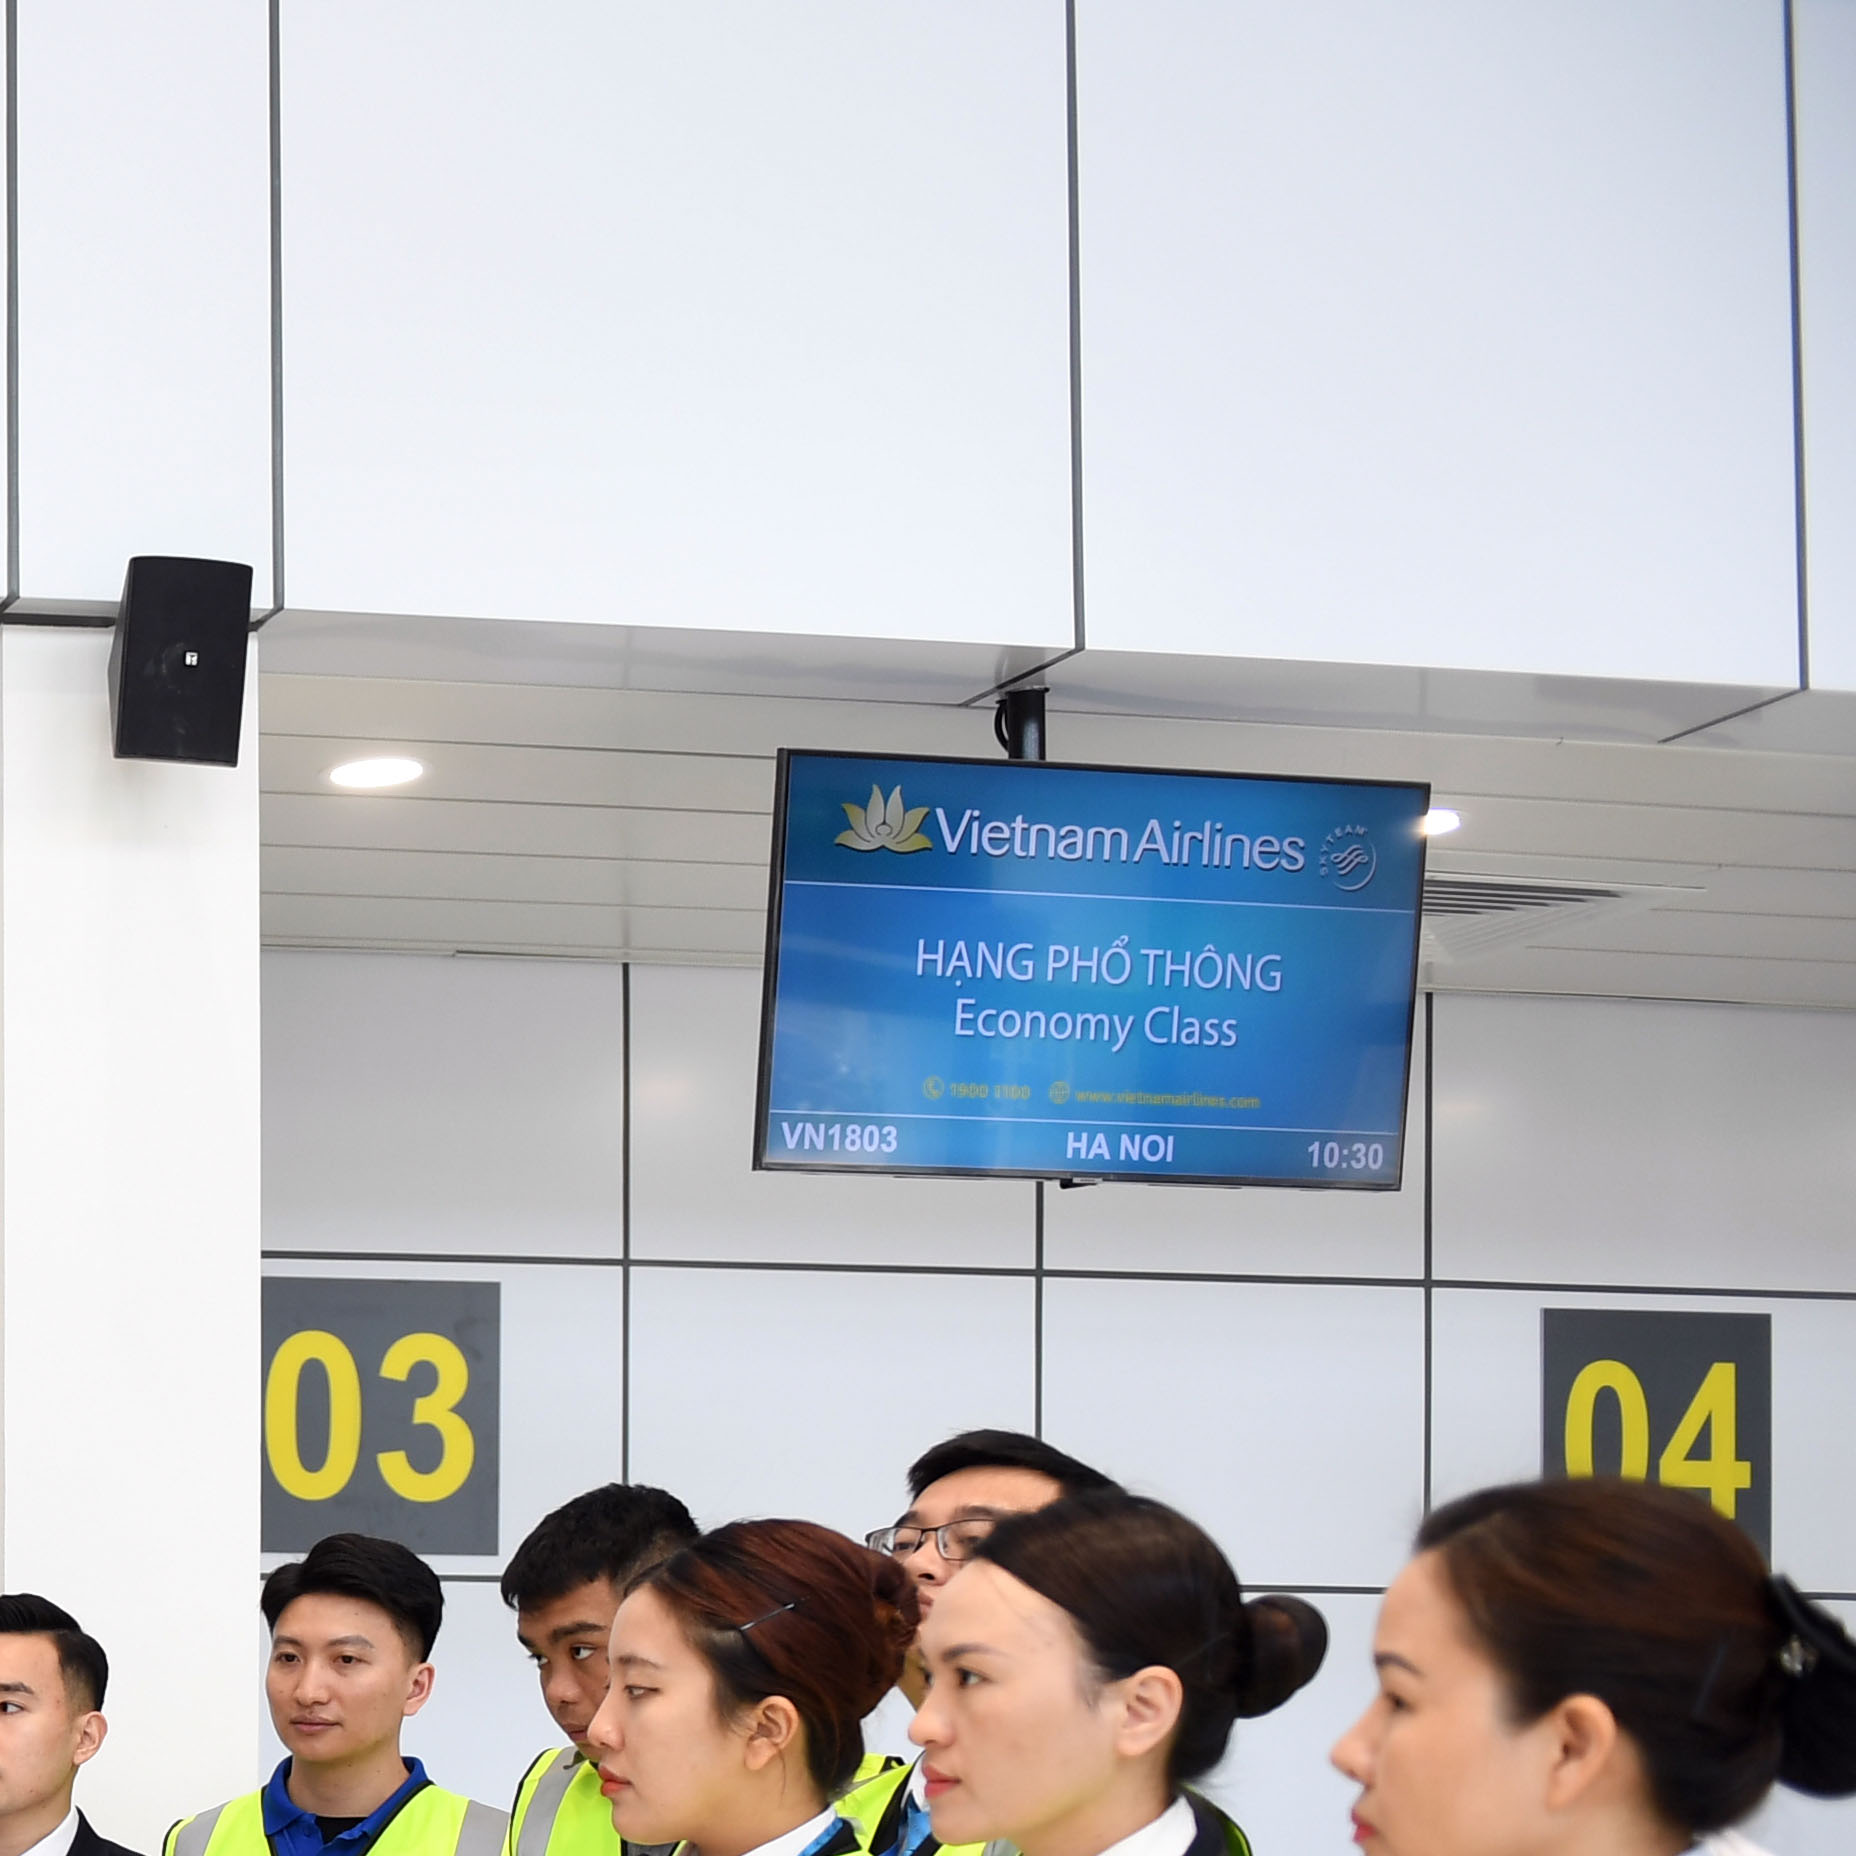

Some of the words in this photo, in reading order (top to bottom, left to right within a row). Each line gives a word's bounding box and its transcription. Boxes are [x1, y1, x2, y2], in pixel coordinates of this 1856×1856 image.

[935, 807, 1129, 862] Vietnam
[1133, 819, 1305, 872] Airlines
[1319, 824, 1365, 876] SKYTEAM
[916, 939, 1035, 988] HẠNG
[1047, 935, 1132, 986] PHỔ
[1141, 944, 1282, 992] THÔNG
[954, 998, 1134, 1053] Economy
[1144, 1005, 1238, 1048] Class
[781, 1121, 898, 1154] VN1803
[1066, 1132, 1111, 1161] HA
[1119, 1133, 1175, 1163] NOI
[1307, 1141, 1384, 1170] 10:30
[265, 1329, 476, 1503] 03
[1564, 1359, 1752, 1520] 04
